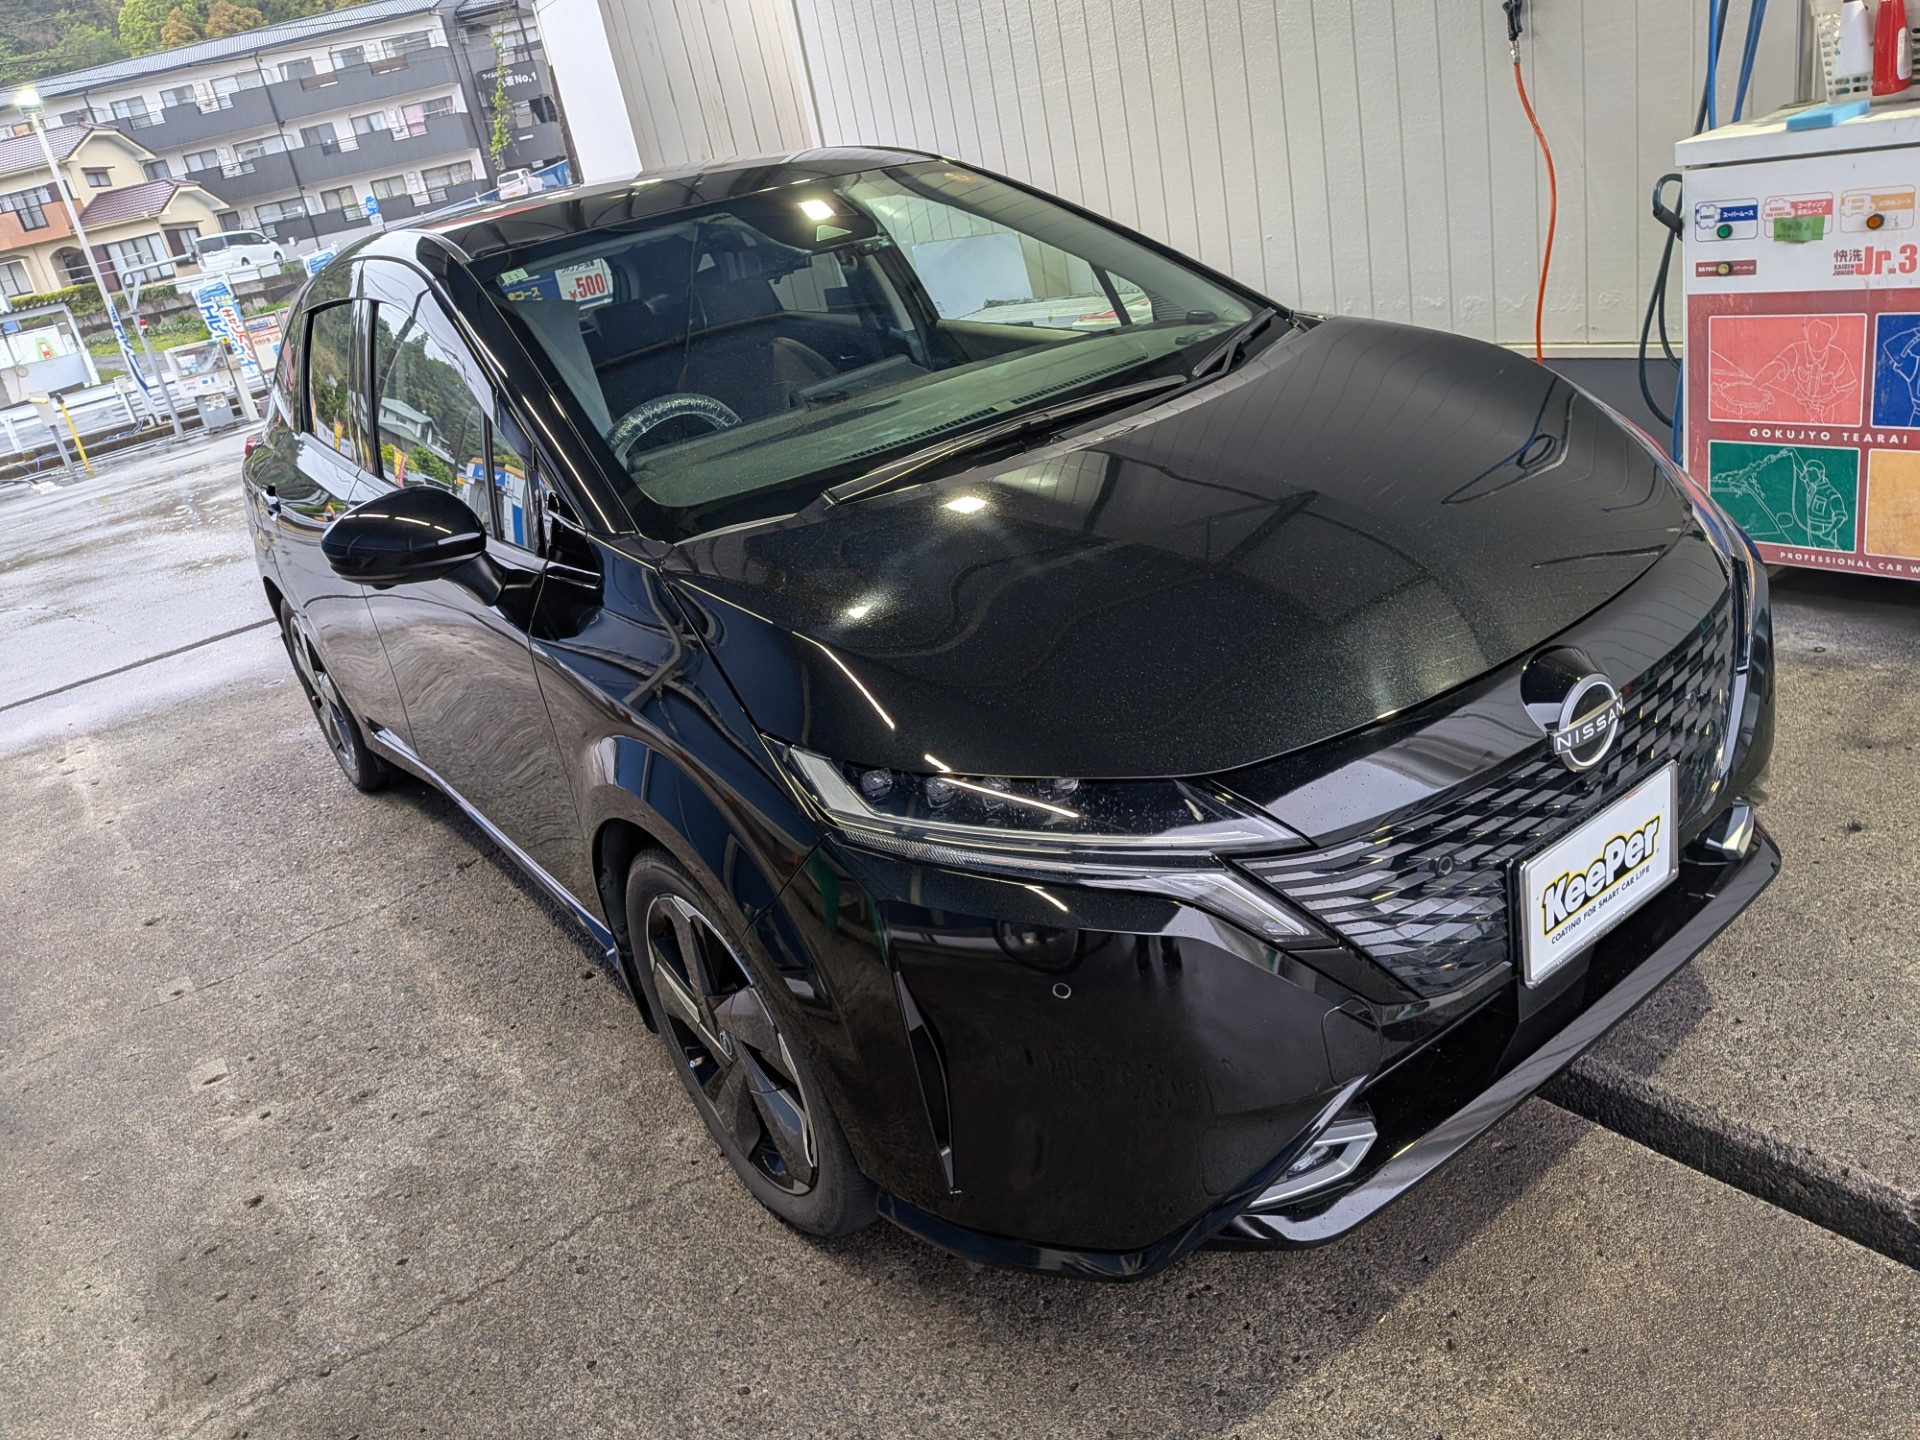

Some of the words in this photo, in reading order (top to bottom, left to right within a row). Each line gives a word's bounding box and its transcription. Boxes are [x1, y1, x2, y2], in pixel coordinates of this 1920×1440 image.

[1833, 249, 1863, 263] 快洗
[1855, 244, 1918, 275] Jr.3
[568, 272, 606, 300] ¥500
[1749, 428, 1831, 441] GOKUJYO
[1843, 432, 1908, 444] TEARAI
[1780, 551, 1871, 569] PROFESSIONAL
[1878, 561, 1903, 572] CAR
[1556, 695, 1624, 750] NISSAN
[1541, 816, 1661, 936] KeePer
[1551, 916, 1582, 945] COATING
[1583, 904, 1597, 921] FOR
[1598, 888, 1621, 910] SMART
[1621, 878, 1635, 894] CAR
[1635, 865, 1651, 884] LIFE
